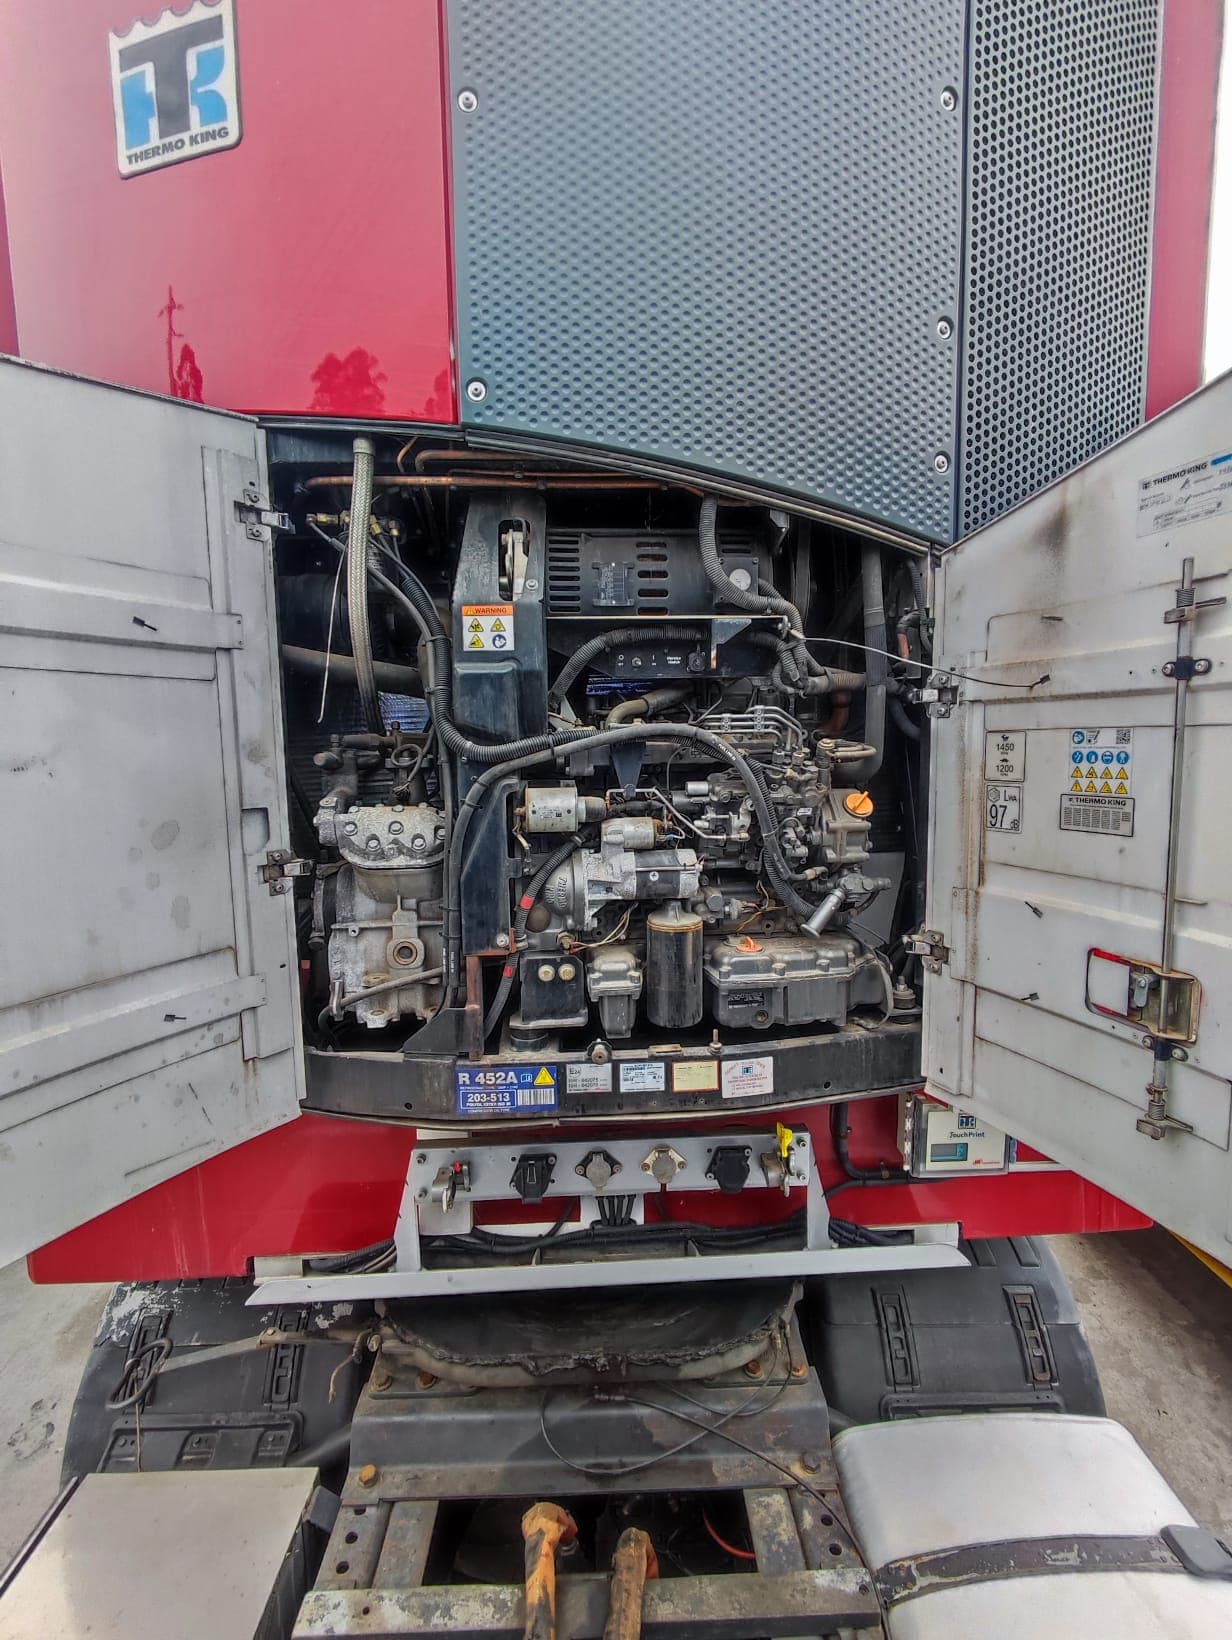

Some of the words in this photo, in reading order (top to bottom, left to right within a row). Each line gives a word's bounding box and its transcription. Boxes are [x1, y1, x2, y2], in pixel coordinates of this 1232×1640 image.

[126, 138, 186, 166] THERMO
[188, 126, 230, 147] KING
[1152, 469, 1186, 487] THERMO
[1186, 462, 1209, 475] KING
[996, 743, 1015, 752] 1450
[995, 764, 1014, 773] 1200
[1075, 796, 1107, 805] THERMO
[1107, 799, 1127, 807] KING
[989, 803, 1008, 828] 97
[458, 1072, 470, 1085] R
[475, 1071, 518, 1085] 452A
[467, 1092, 511, 1103] 203-513
